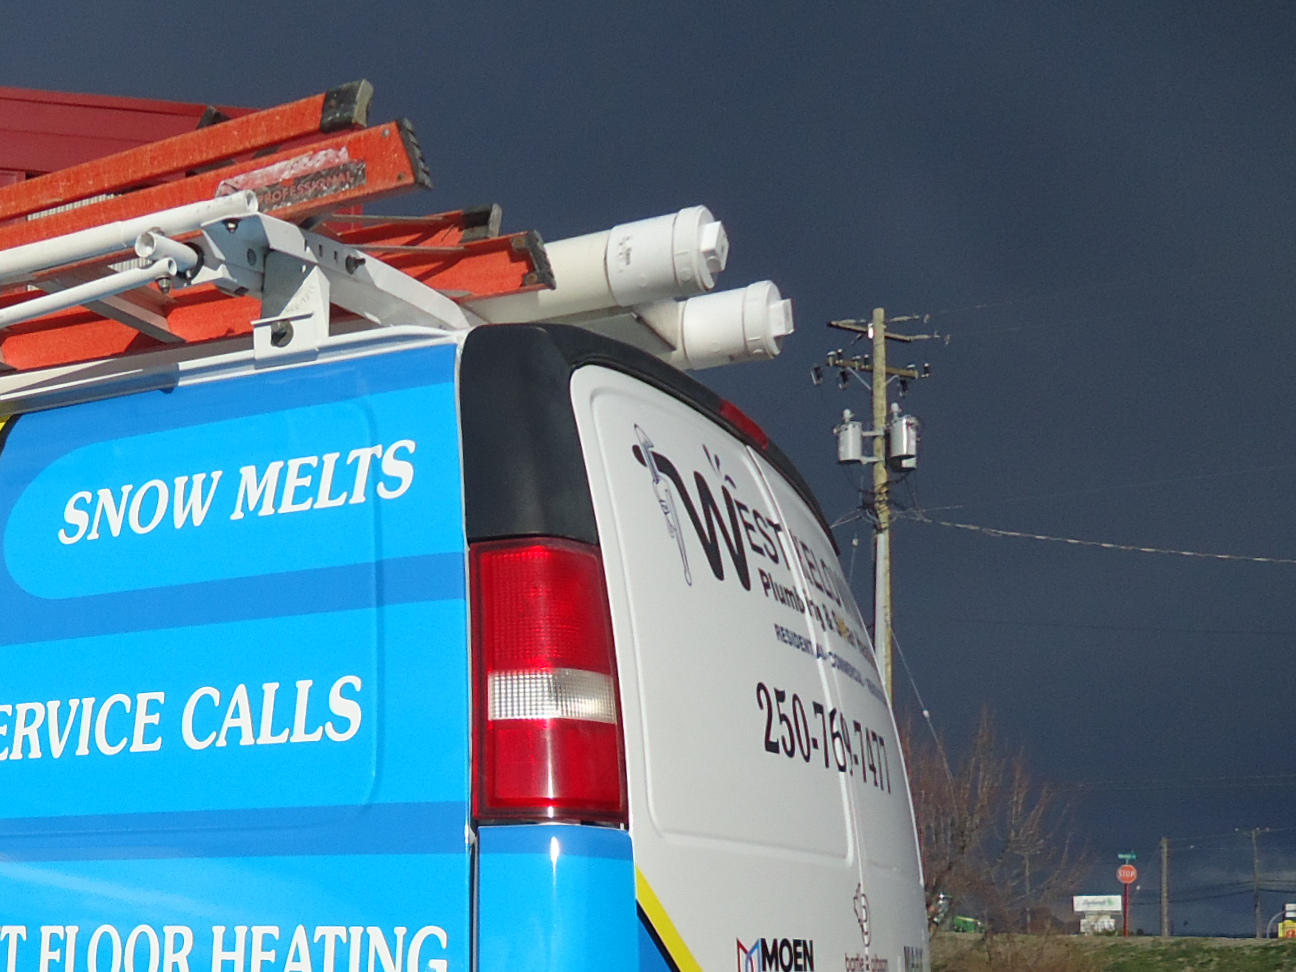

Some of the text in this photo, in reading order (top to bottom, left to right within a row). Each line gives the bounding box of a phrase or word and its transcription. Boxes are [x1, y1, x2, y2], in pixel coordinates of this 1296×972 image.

[58, 439, 416, 545] SNOW MELTS
[181, 674, 362, 750] CALLS
[756, 681, 891, 794] 250-769-7477
[1118, 870, 1136, 878] STOP
[761, 937, 815, 972] MOEN
